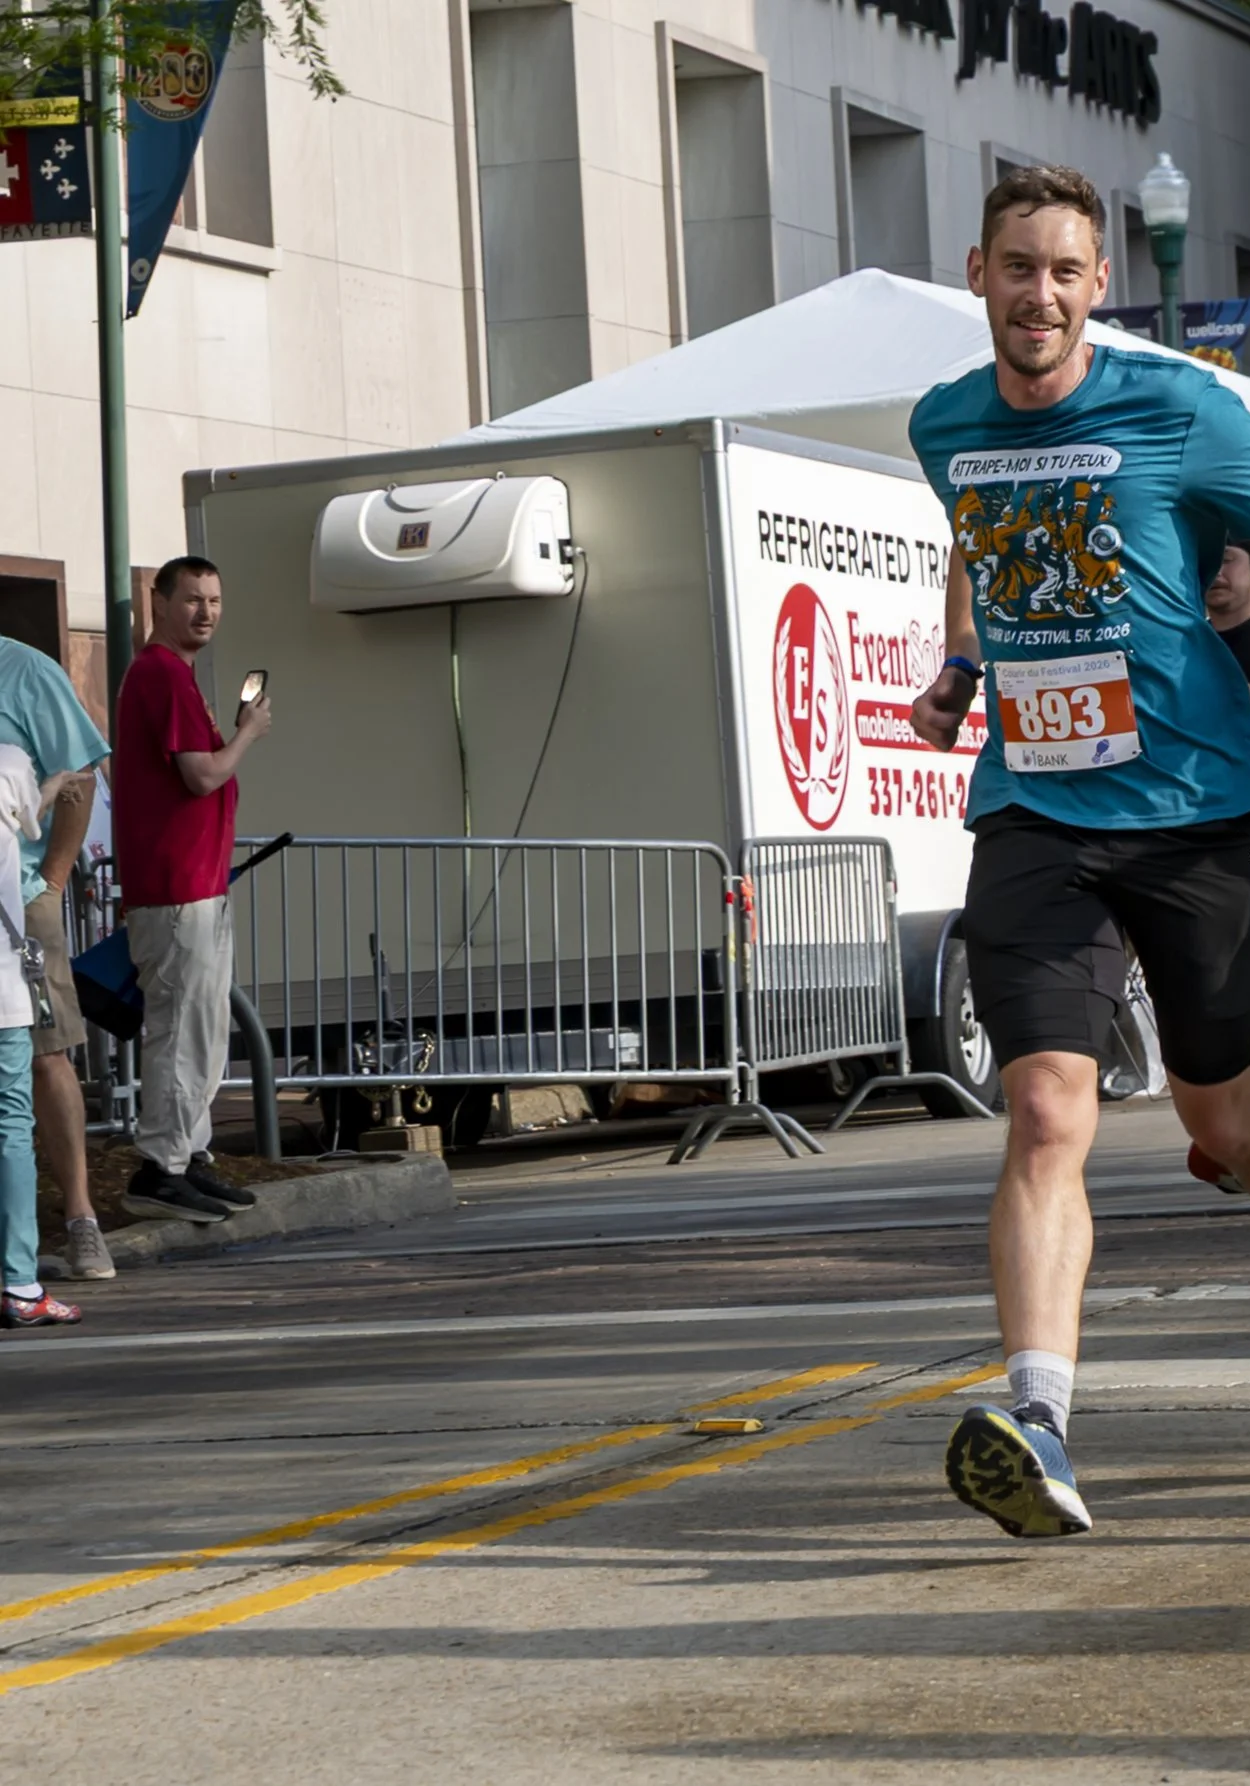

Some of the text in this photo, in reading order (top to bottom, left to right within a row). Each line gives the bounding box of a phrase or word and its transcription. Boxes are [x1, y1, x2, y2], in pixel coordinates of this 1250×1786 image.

[1068, 2, 1162, 125] ARTS
[1186, 322, 1246, 338] wellcare
[952, 453, 1112, 478] ATTRAPE-MOI SI TU PEUX!
[758, 510, 948, 589] REFRIGERATED TRA
[847, 611, 944, 689] EventSol
[1017, 629, 1071, 645] FESTIVAL
[1075, 628, 1092, 642] 5K
[1095, 622, 1131, 642] 2026
[1028, 667, 1040, 677] du
[1041, 662, 1081, 676] Festival
[1084, 660, 1110, 672] 2026
[1016, 686, 1106, 741] 893
[868, 767, 966, 820] 337-261-2
